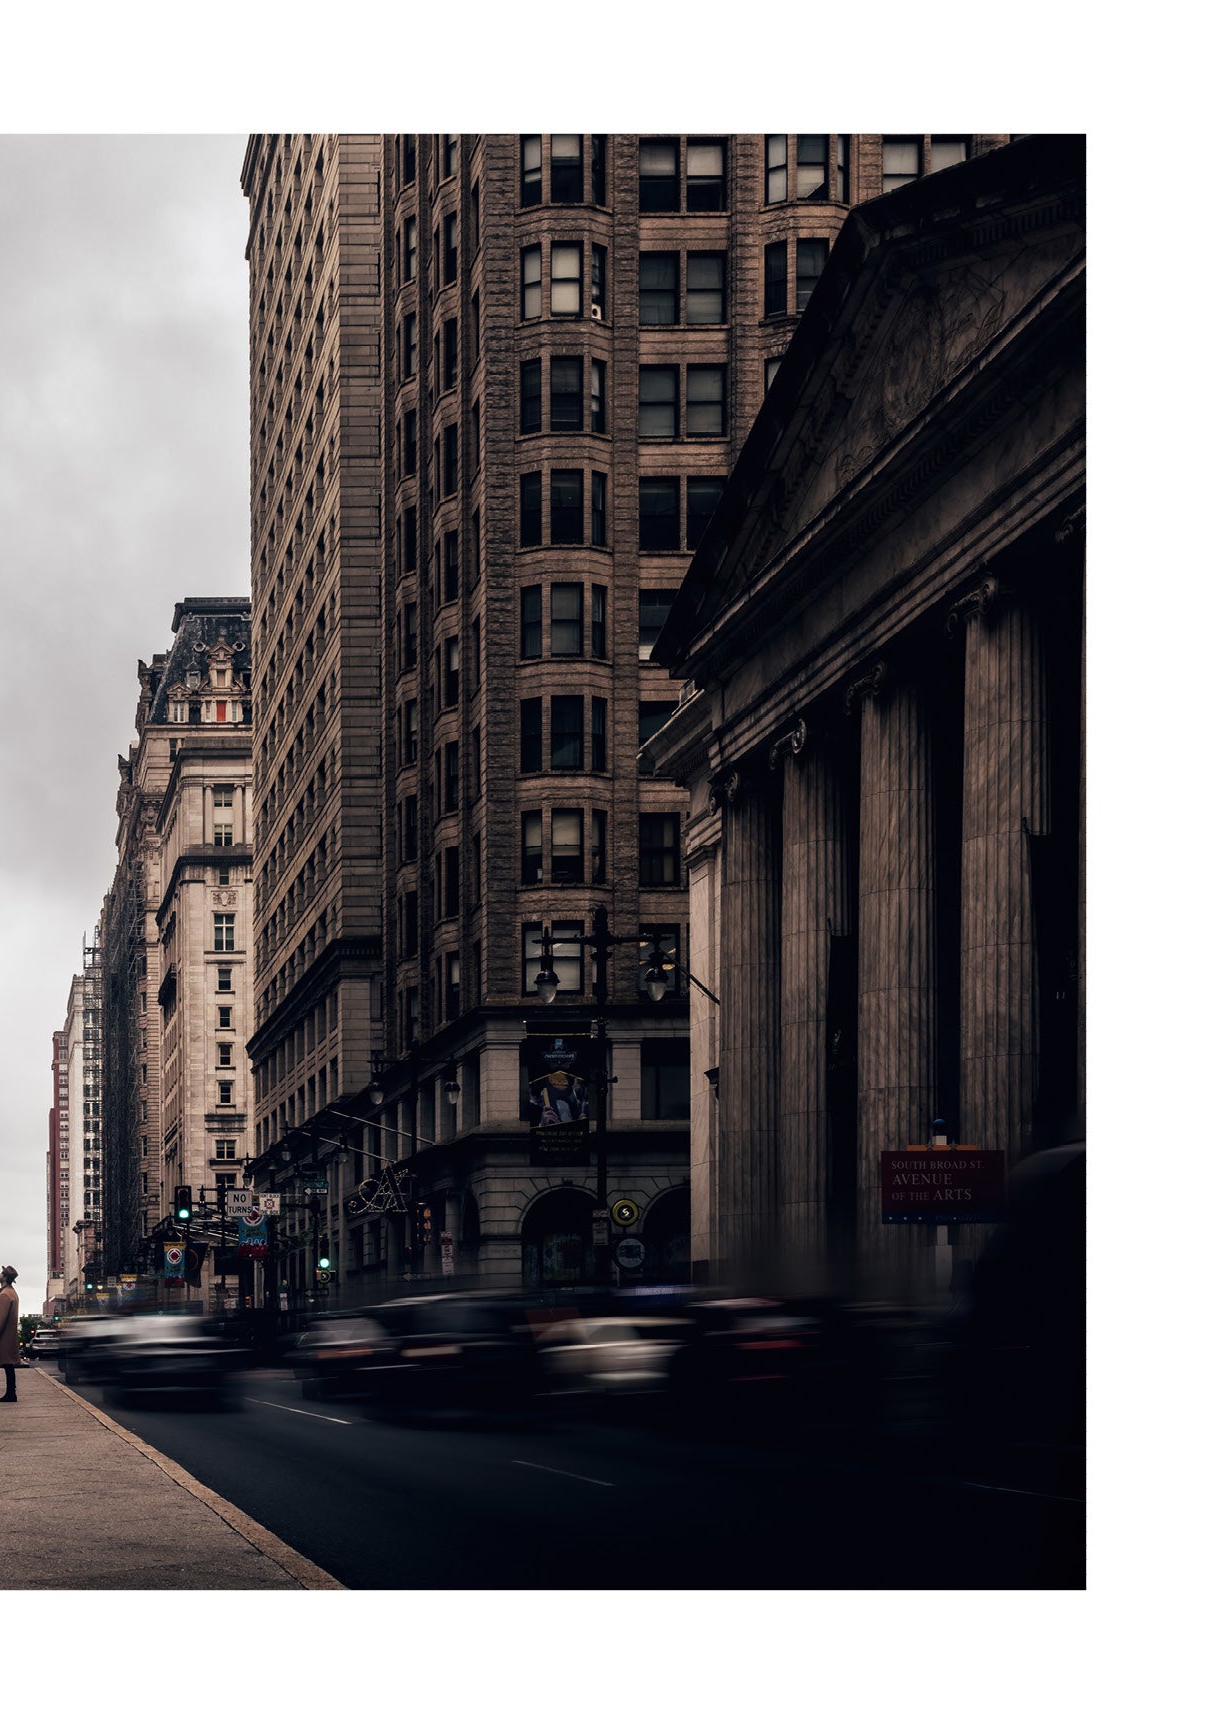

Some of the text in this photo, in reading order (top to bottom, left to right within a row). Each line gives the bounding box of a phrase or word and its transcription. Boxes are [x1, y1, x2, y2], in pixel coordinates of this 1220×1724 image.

[891, 1160, 985, 1170] SOUTH BROAD ST.
[892, 1173, 953, 1185] AVENUE
[233, 1194, 247, 1203] NO
[891, 1188, 972, 1201] OF THE ARTS
[228, 1206, 252, 1214] TURNS
